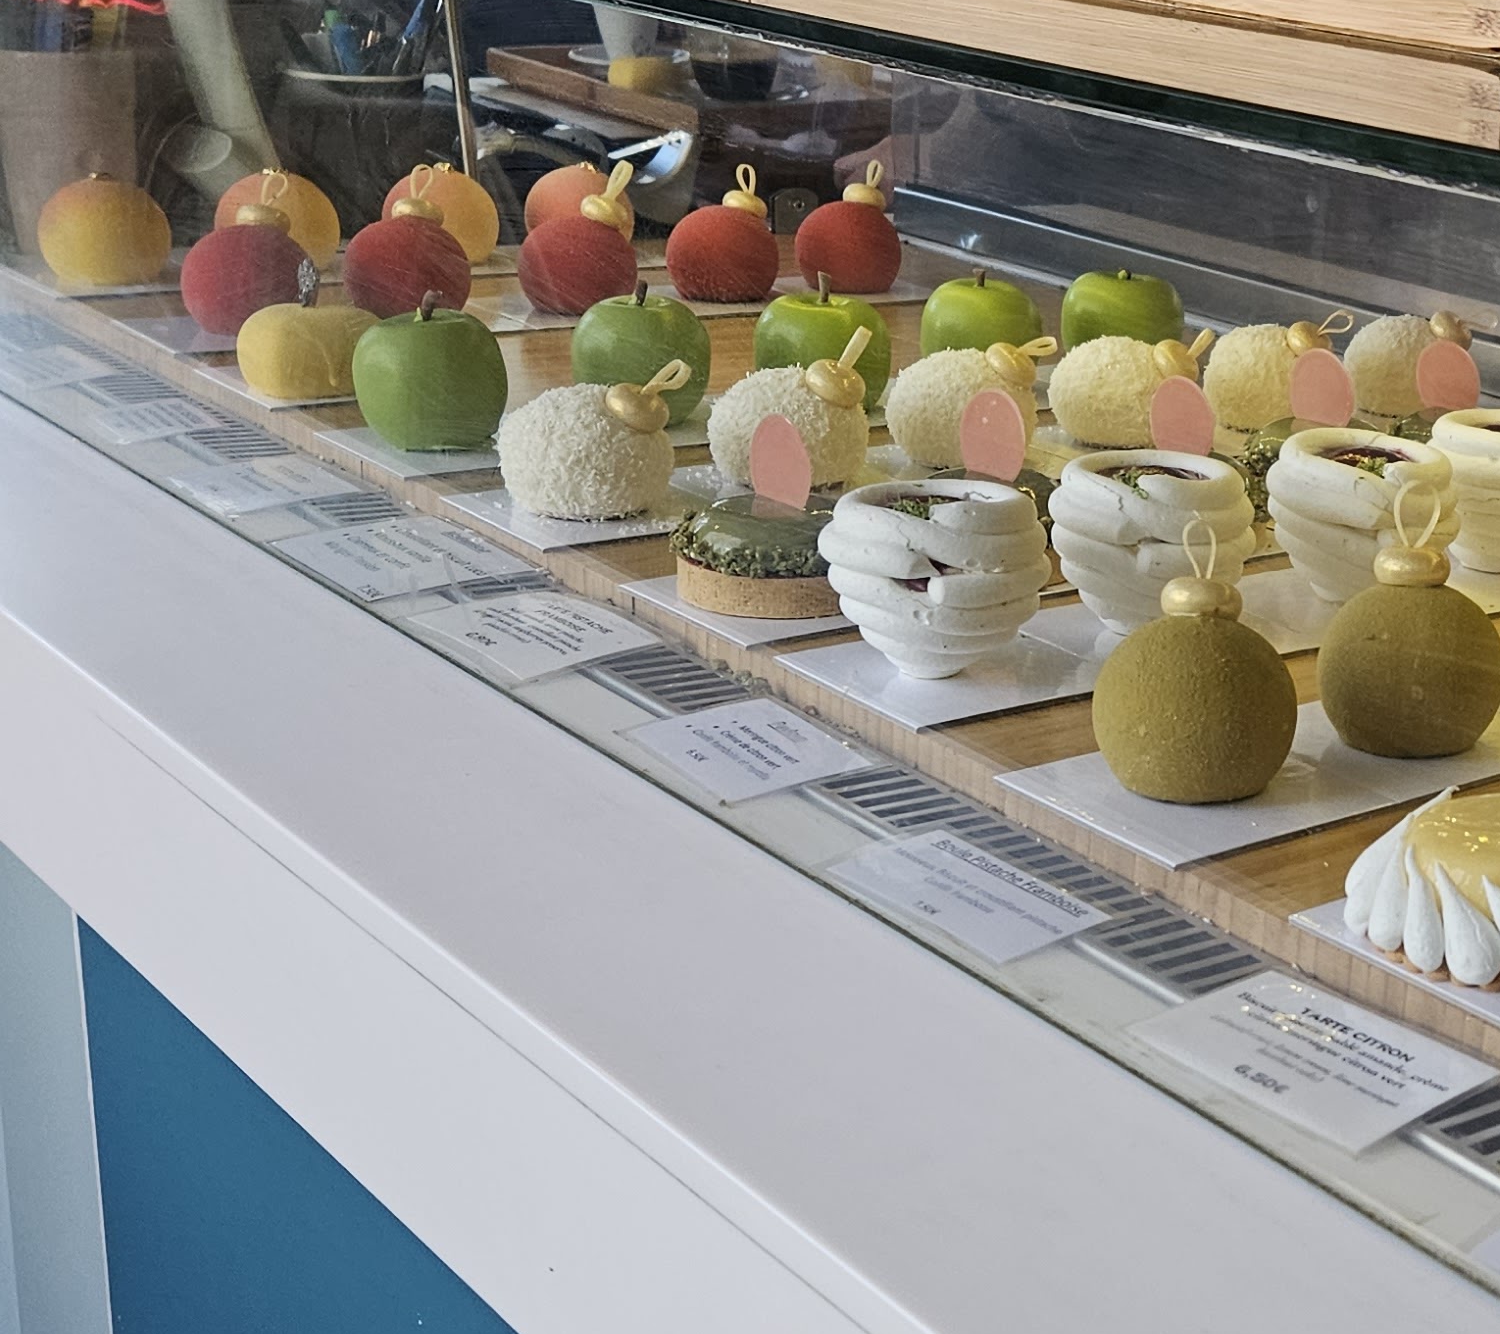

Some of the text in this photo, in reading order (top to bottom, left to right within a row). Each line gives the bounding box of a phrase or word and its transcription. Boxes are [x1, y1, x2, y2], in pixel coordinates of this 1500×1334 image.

[936, 838, 1090, 917] Boule Pistache Framboise
[1301, 1006, 1353, 1035] TARTE
[1353, 1031, 1416, 1064] CITRON
